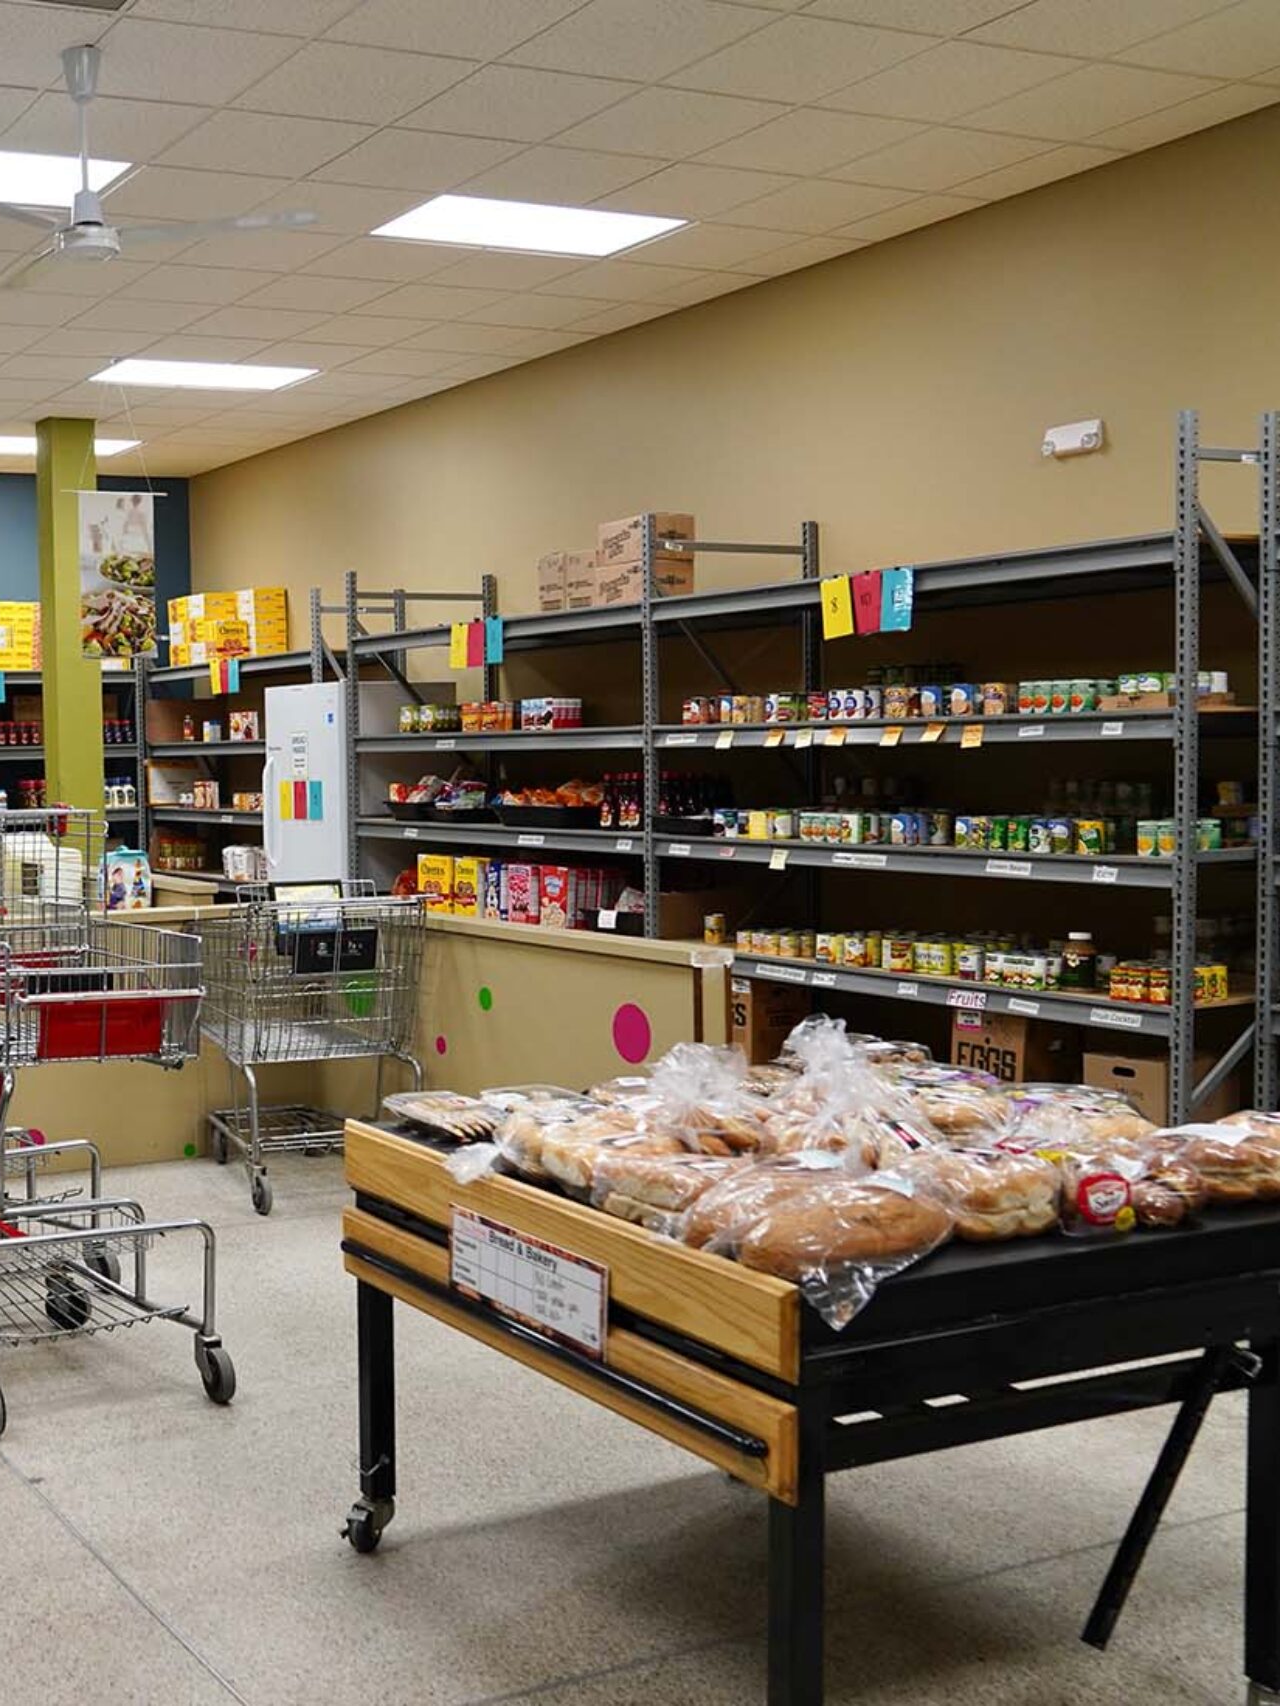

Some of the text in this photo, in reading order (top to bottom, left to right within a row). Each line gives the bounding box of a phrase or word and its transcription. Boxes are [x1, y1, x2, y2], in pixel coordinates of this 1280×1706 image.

[948, 988, 987, 1009] Fruits
[957, 1041, 1017, 1081] EGGS
[487, 1229, 515, 1252] Bread
[524, 1245, 558, 1274] Bakery
